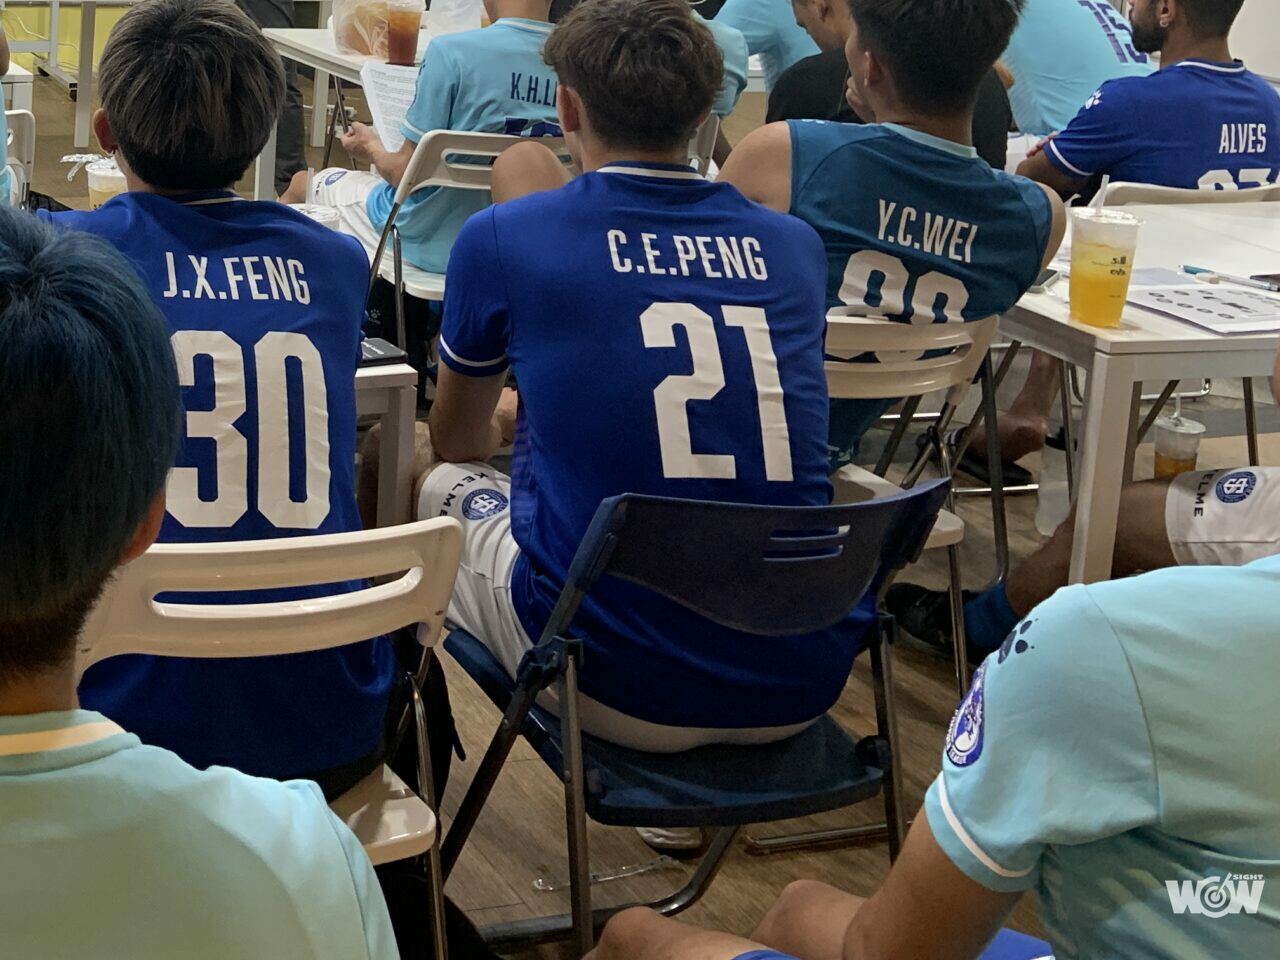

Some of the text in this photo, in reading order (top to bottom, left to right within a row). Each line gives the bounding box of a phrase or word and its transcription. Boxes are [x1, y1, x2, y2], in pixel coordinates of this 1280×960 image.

[1218, 123, 1267, 154] ALVES
[607, 229, 769, 281] C.E.PENG
[877, 198, 979, 264] Y.C.WEI
[163, 251, 311, 305] J.X.FENG
[639, 302, 794, 482] 21
[165, 330, 332, 529] 30
[439, 472, 489, 516] KELME
[1193, 469, 1220, 517] ELME
